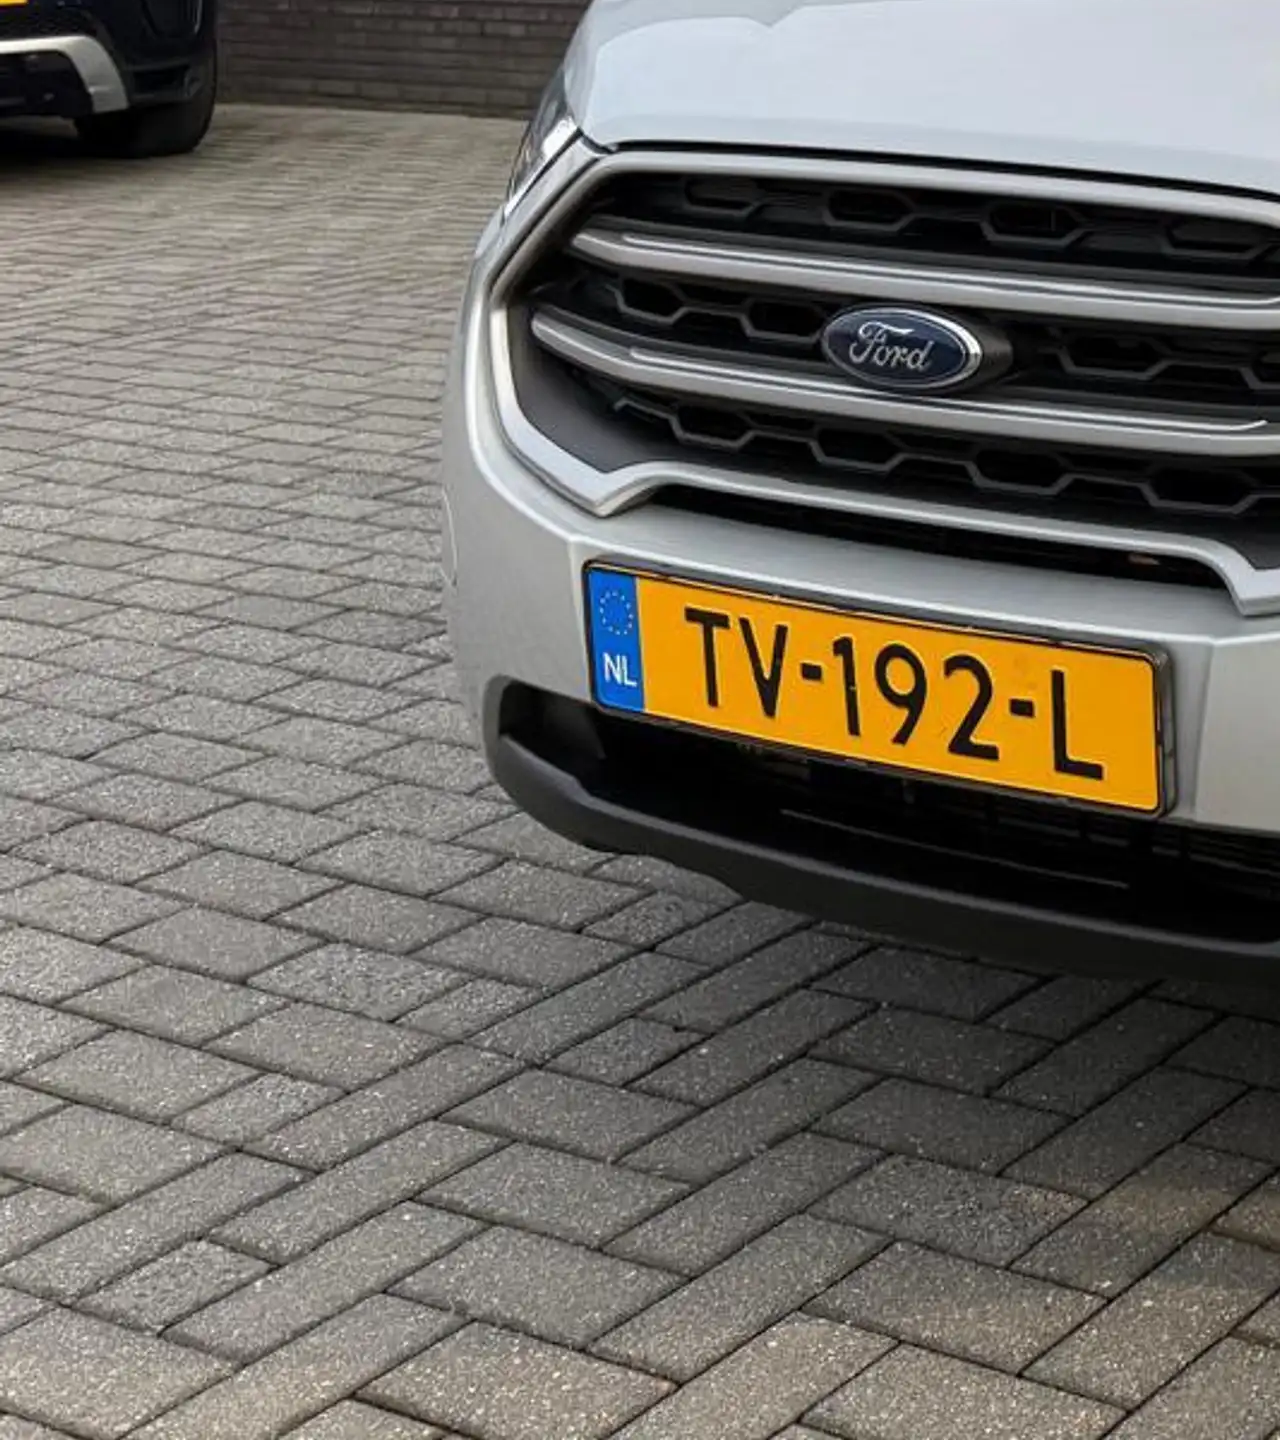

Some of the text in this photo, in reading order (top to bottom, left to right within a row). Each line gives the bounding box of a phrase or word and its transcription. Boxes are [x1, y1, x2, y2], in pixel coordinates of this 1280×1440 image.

[849, 320, 932, 372] Ford
[603, 652, 638, 687] NL
[684, 606, 1104, 781] TV-192-L
